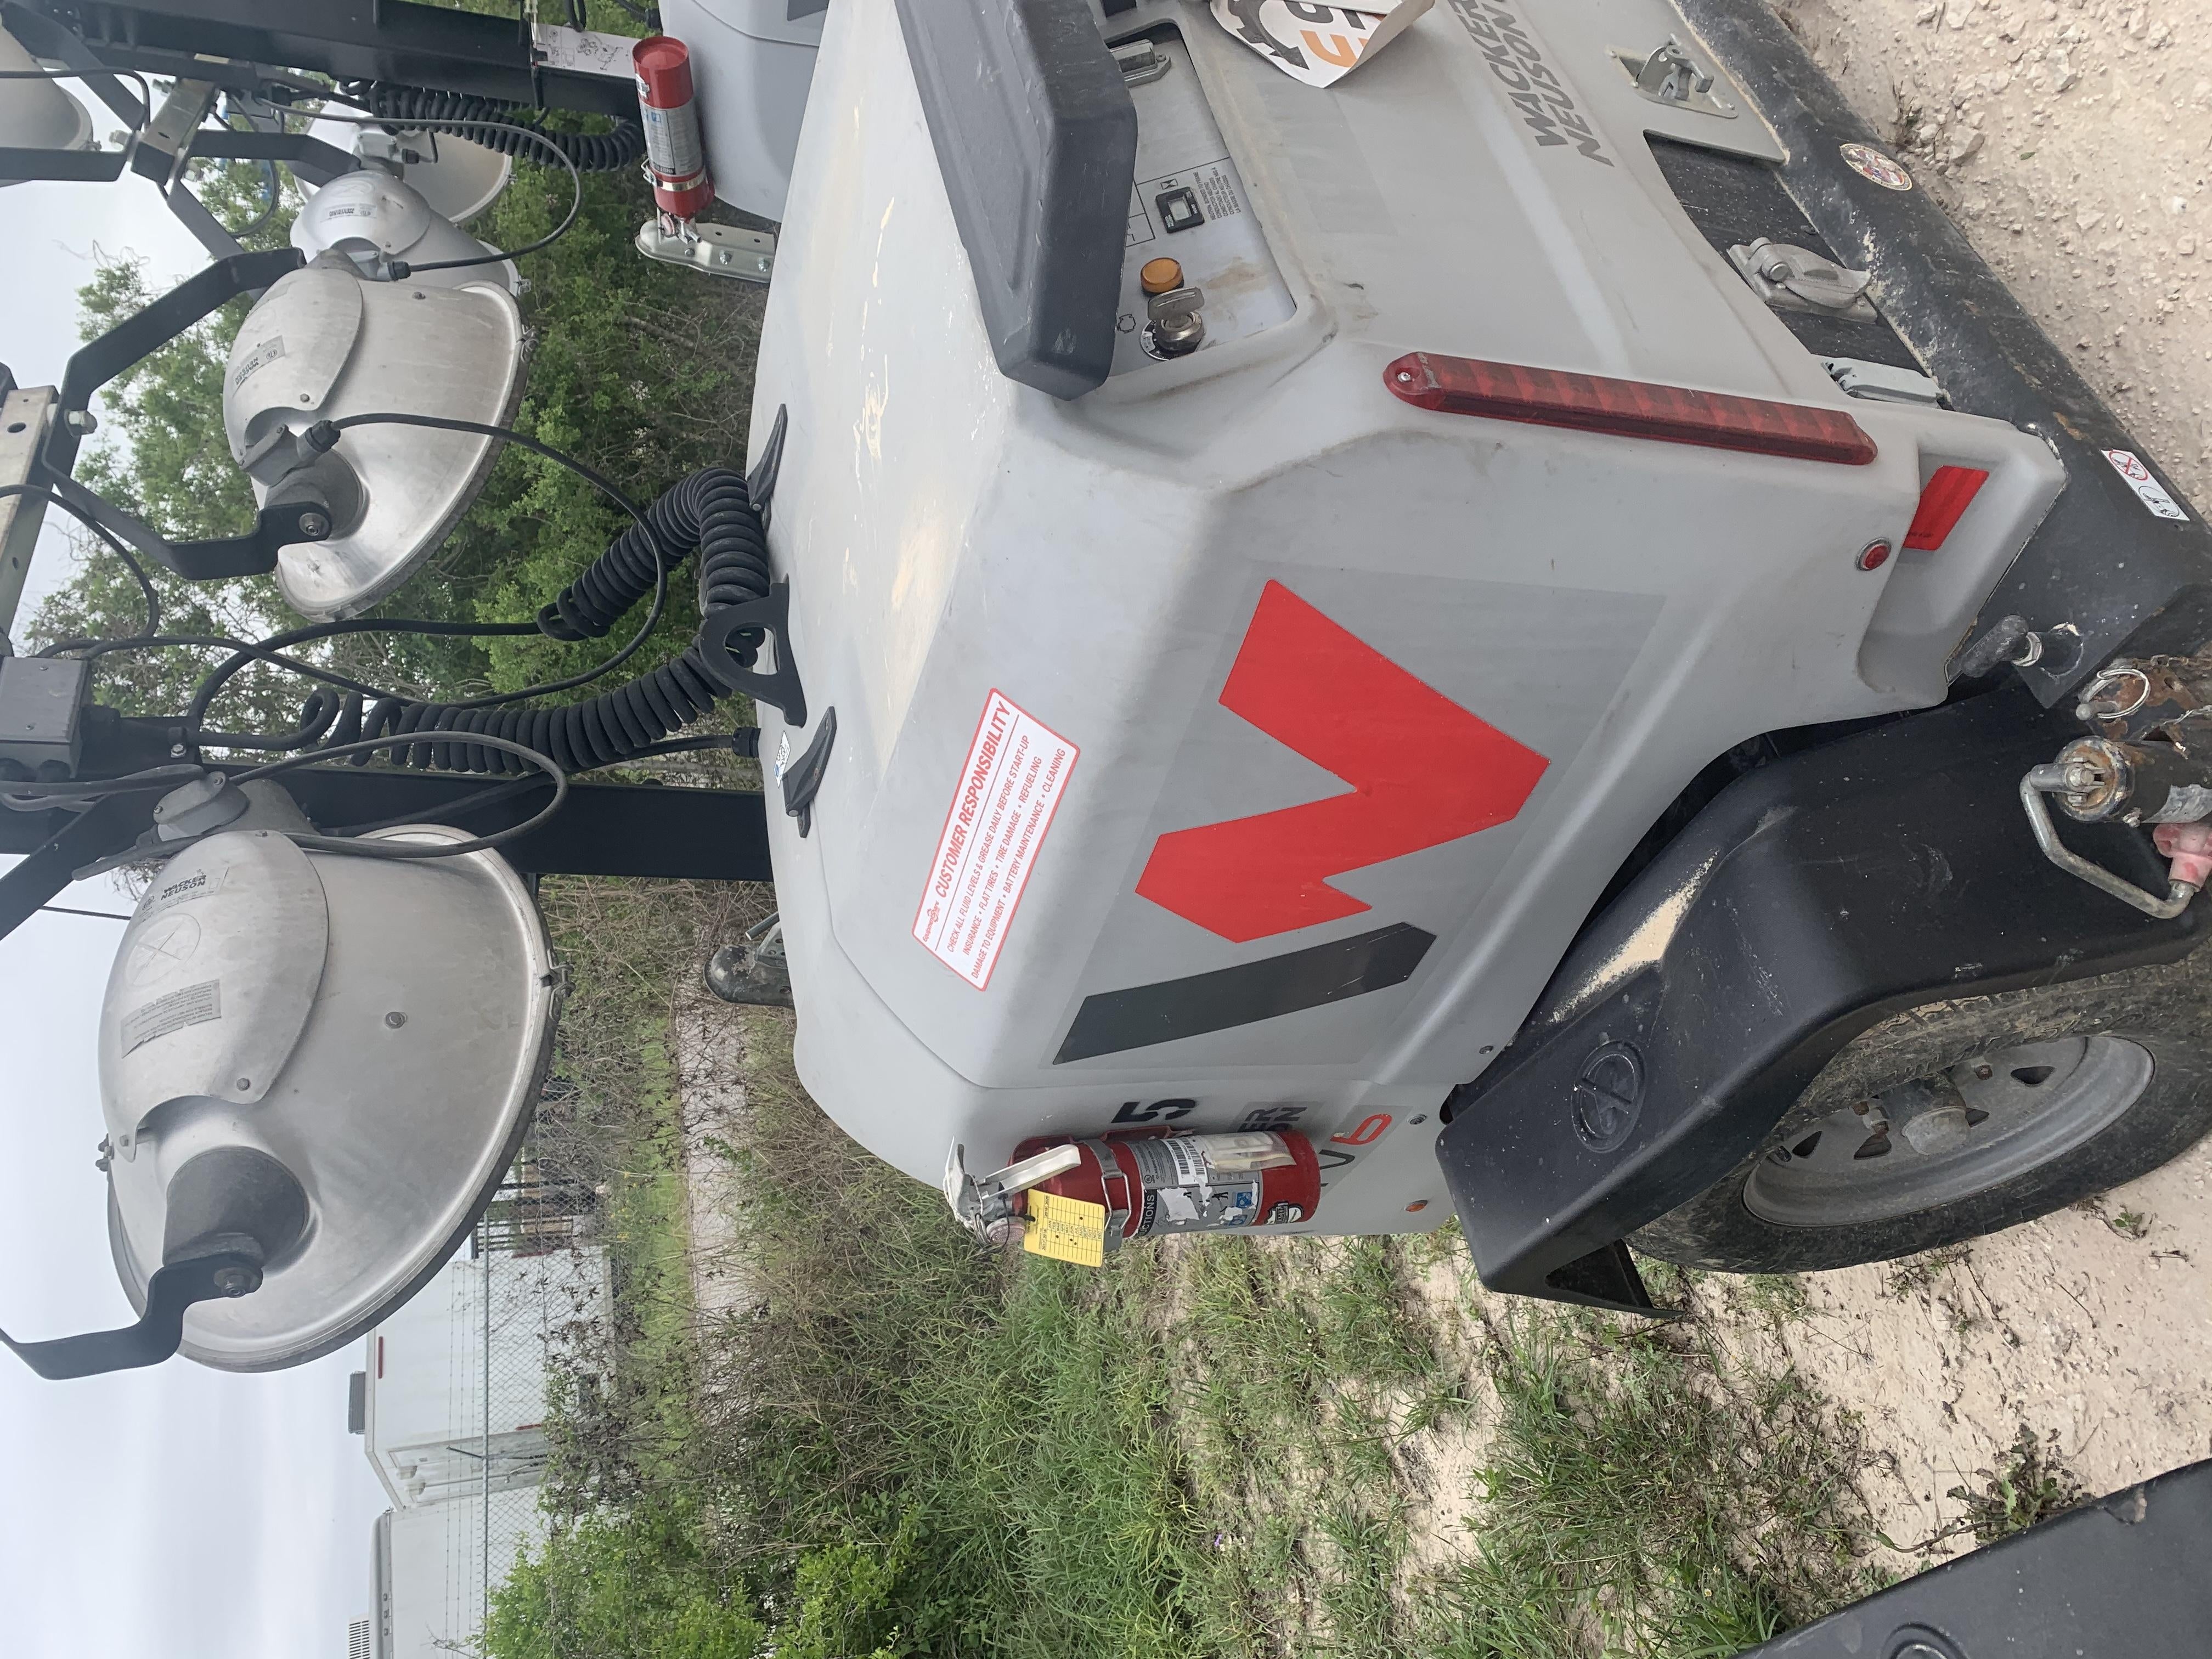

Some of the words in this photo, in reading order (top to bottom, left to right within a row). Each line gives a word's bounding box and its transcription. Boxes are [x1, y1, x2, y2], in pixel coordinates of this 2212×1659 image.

[1447, 0, 1568, 146] WACKER
[1482, 3, 1615, 166] NEUSON
[1009, 735, 1030, 777] START-UP
[1042, 748, 1065, 792] CLEANING
[935, 823, 967, 897] CUSTOMER
[958, 700, 1010, 826] RESPONSIBILITY
[997, 776, 1014, 810] BEFORE
[989, 808, 1002, 833] DAILY
[1015, 799, 1045, 859] MAINTENANCE
[962, 915, 982, 955] INSURANCE
[979, 891, 990, 910] FLAT
[985, 870, 998, 891] TIRES
[995, 844, 1008, 862] TIRE
[1002, 809, 1022, 845] DAMAGE
[1018, 756, 1042, 803] REFUELING
[978, 831, 994, 862] GREASE
[160, 879, 206, 900] NEUSON
[163, 874, 207, 893] WACKER
[966, 868, 981, 896] LEVELS
[1003, 857, 1020, 893] BATTERY
[955, 916, 964, 929] ALL
[959, 895, 970, 916] FLUID
[985, 898, 1006, 939] EQUIPMENT
[947, 929, 960, 952] CHECK
[981, 939, 991, 949] TO
[971, 949, 987, 978] DAMAGE
[1318, 1113, 1392, 1186] V6
